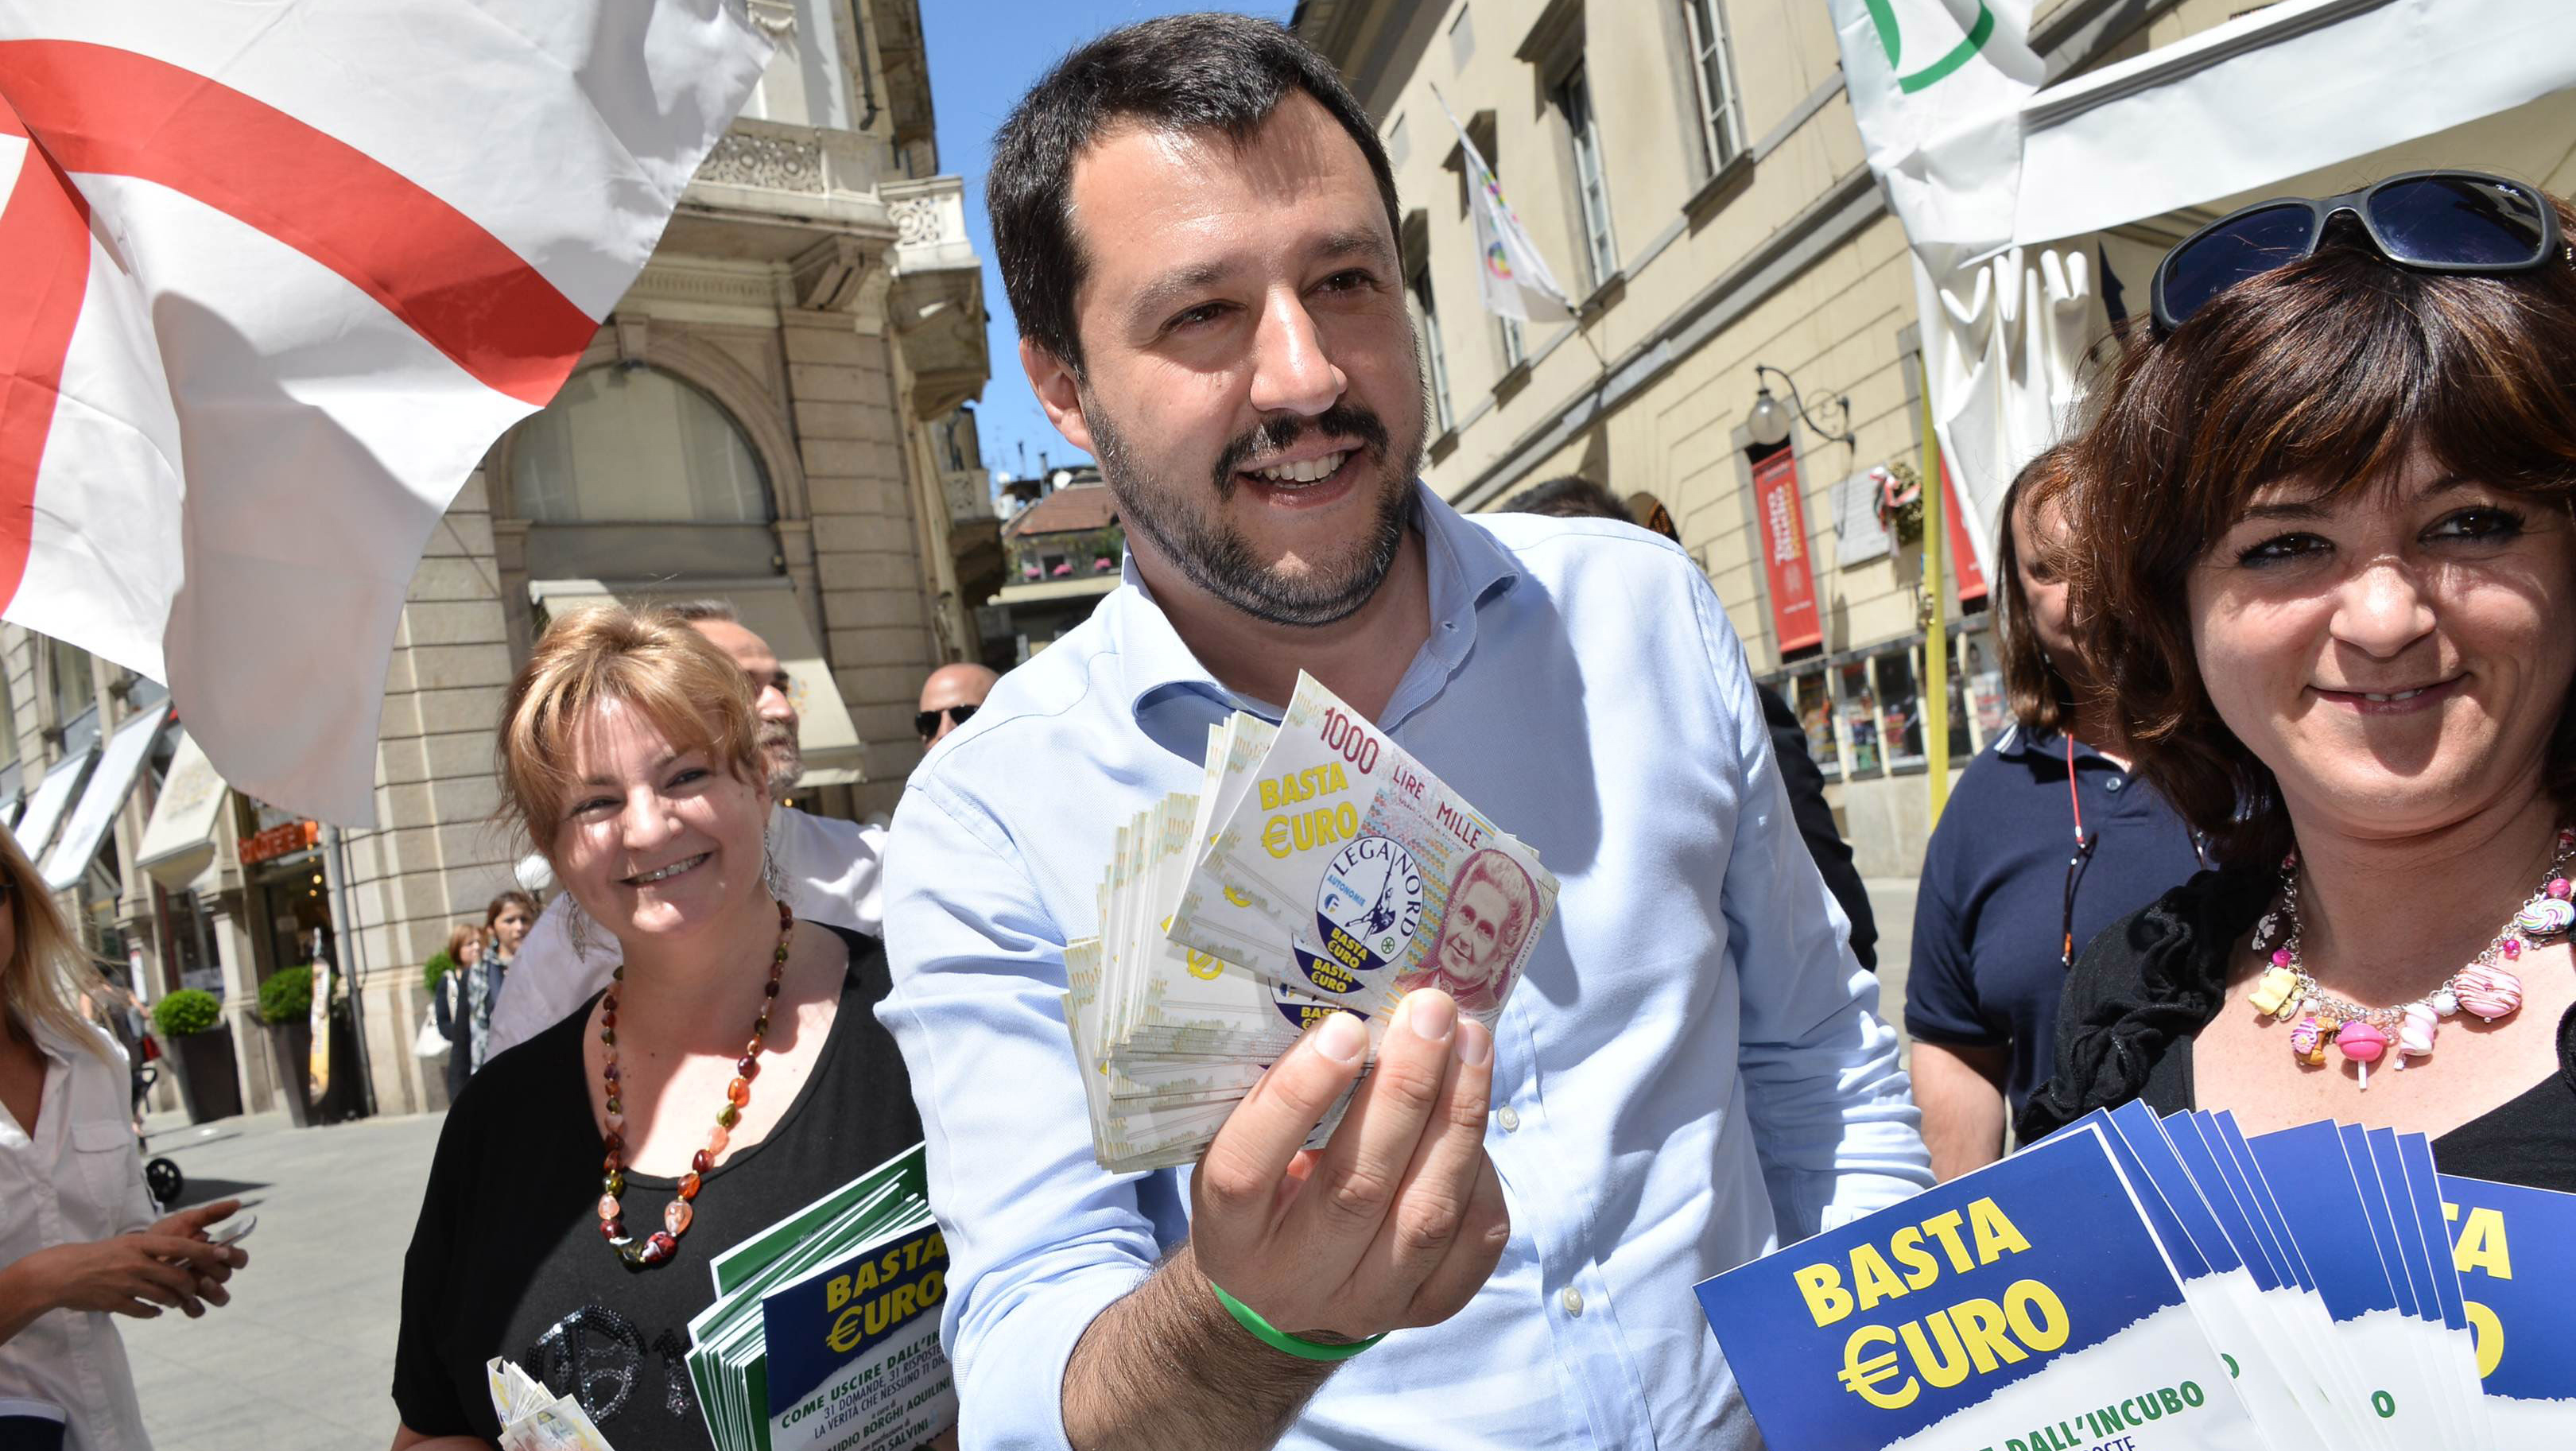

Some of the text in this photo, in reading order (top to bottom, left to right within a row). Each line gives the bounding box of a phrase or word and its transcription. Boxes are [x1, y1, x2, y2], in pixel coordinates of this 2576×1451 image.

[1321, 707, 1379, 774] 1000
[1259, 761, 1349, 811] BASTA
[1392, 765, 1425, 800] LIRE
[1436, 801, 1482, 850] MILLE
[1260, 801, 1359, 859] €URO
[1333, 840, 1422, 937] LEGA NORD
[1312, 958, 1353, 983] BASTA
[1328, 940, 1360, 969] €URO
[1331, 927, 1368, 961] BASTA
[1310, 971, 1348, 993] €URO
[826, 1233, 946, 1313] BASTA
[1793, 1197, 2031, 1328] BASTA
[825, 1270, 944, 1352] €URO
[1837, 1278, 2070, 1410] €URO
[782, 1395, 824, 1429] COME
[831, 1363, 881, 1401] USCIRE
[815, 1424, 825, 1440] LA
[861, 1393, 878, 1411] CHE
[880, 1368, 920, 1400] NESSUNO
[923, 1363, 929, 1375] TI
[824, 1404, 834, 1419] 31
[890, 1368, 899, 1382] 31
[863, 1404, 903, 1438] BORGHI
[906, 1375, 951, 1412] AQUILINI
[888, 1418, 929, 1451] SALVINI
